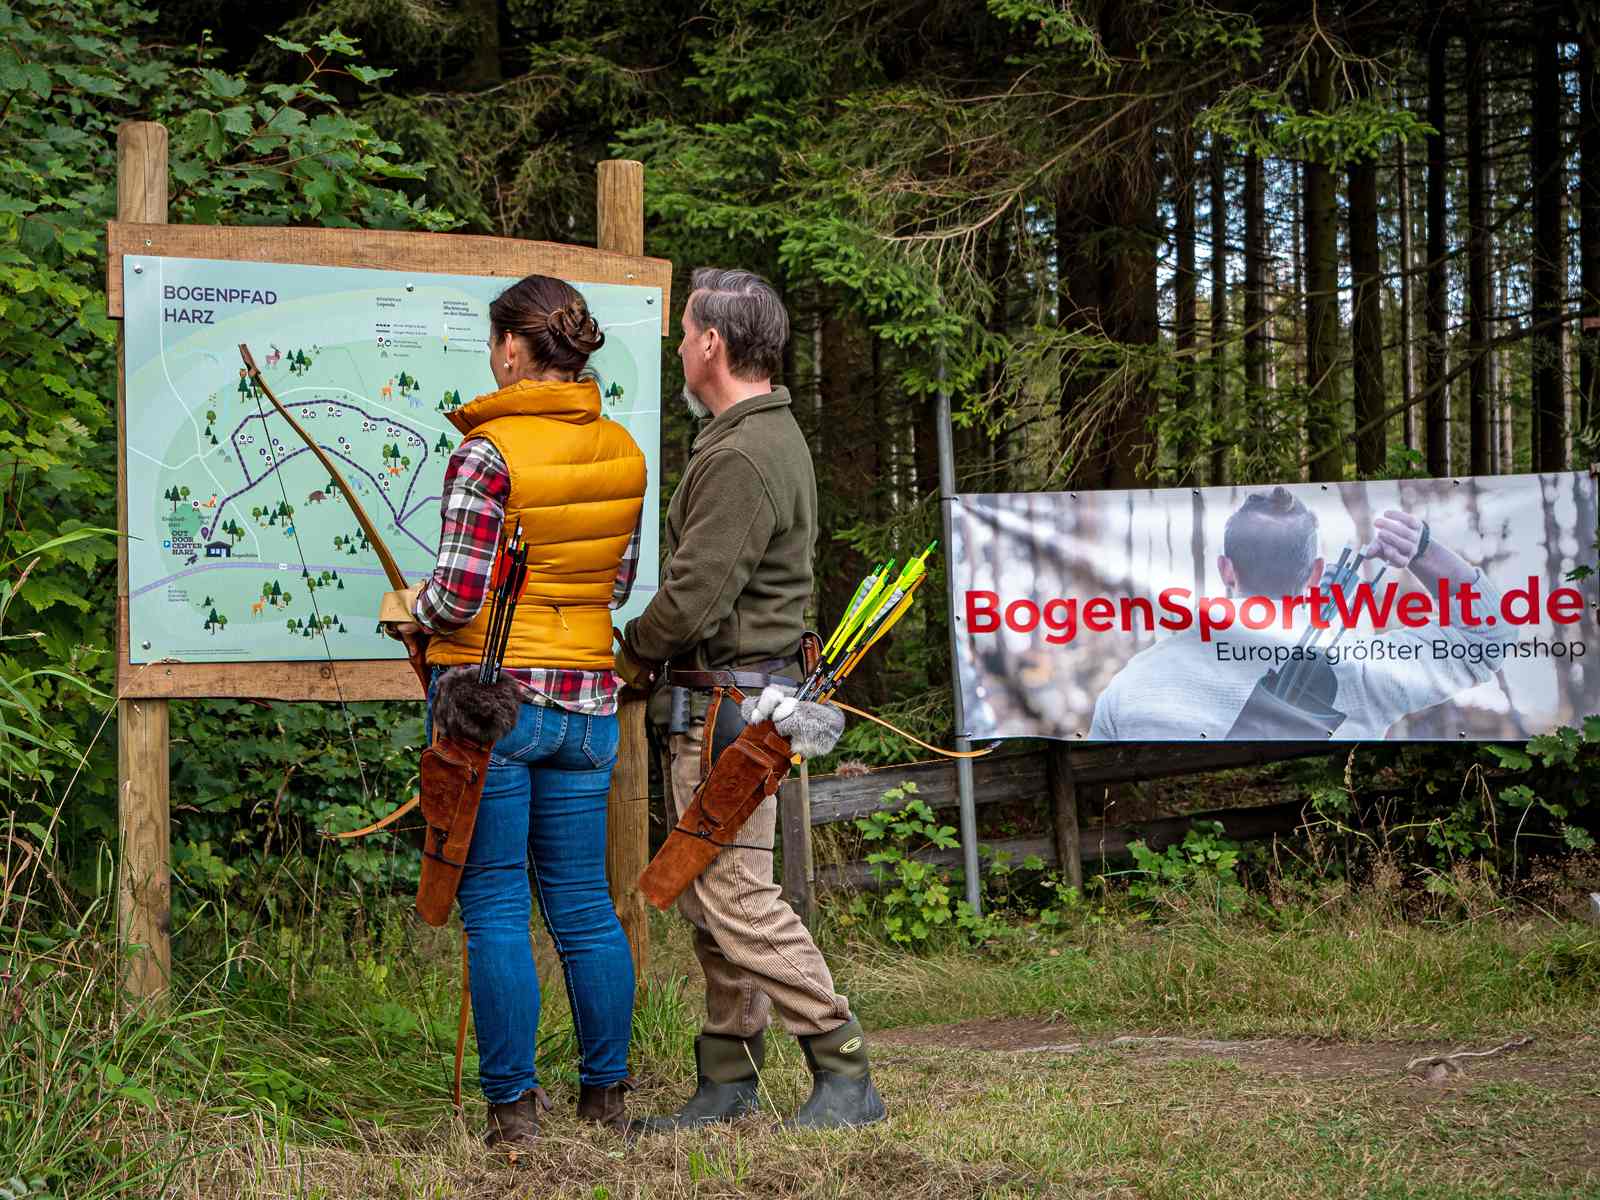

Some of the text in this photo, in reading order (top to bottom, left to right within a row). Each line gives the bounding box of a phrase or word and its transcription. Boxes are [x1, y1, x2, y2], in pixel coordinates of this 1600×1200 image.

[163, 285, 277, 305] BOGENPFAD
[164, 308, 215, 325] HARZ
[965, 576, 1585, 645] BogenSportWelt.de
[1216, 636, 1586, 665] Europas größter Bogenshop
